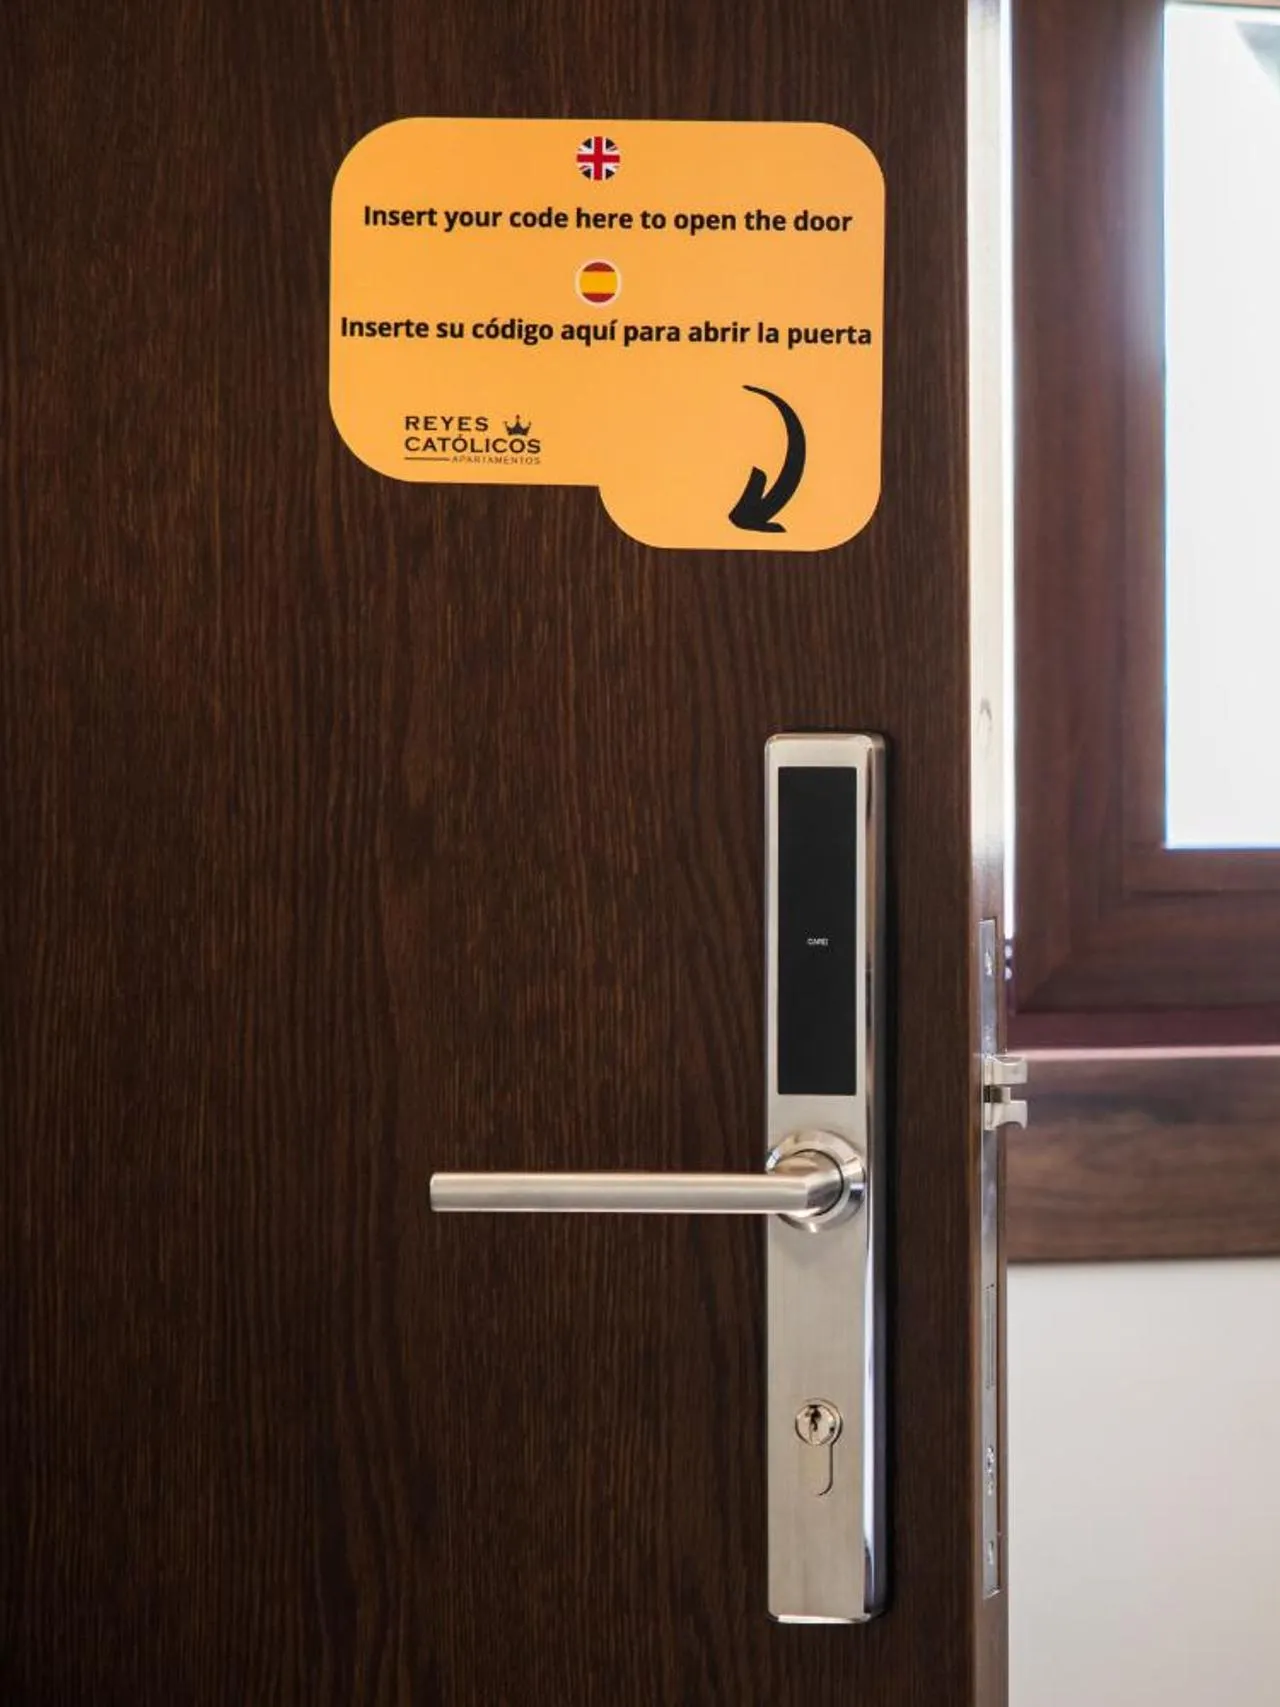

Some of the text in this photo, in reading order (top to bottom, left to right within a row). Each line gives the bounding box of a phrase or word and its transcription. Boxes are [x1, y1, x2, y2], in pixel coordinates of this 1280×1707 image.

[364, 205, 853, 237] Insert your code here to open the door
[341, 316, 872, 351] Inserte su código aquí para abrir la puerta
[405, 415, 489, 433] REYES
[404, 433, 541, 455] CATÓLICOS
[451, 455, 541, 465] APARTAMENTOS
